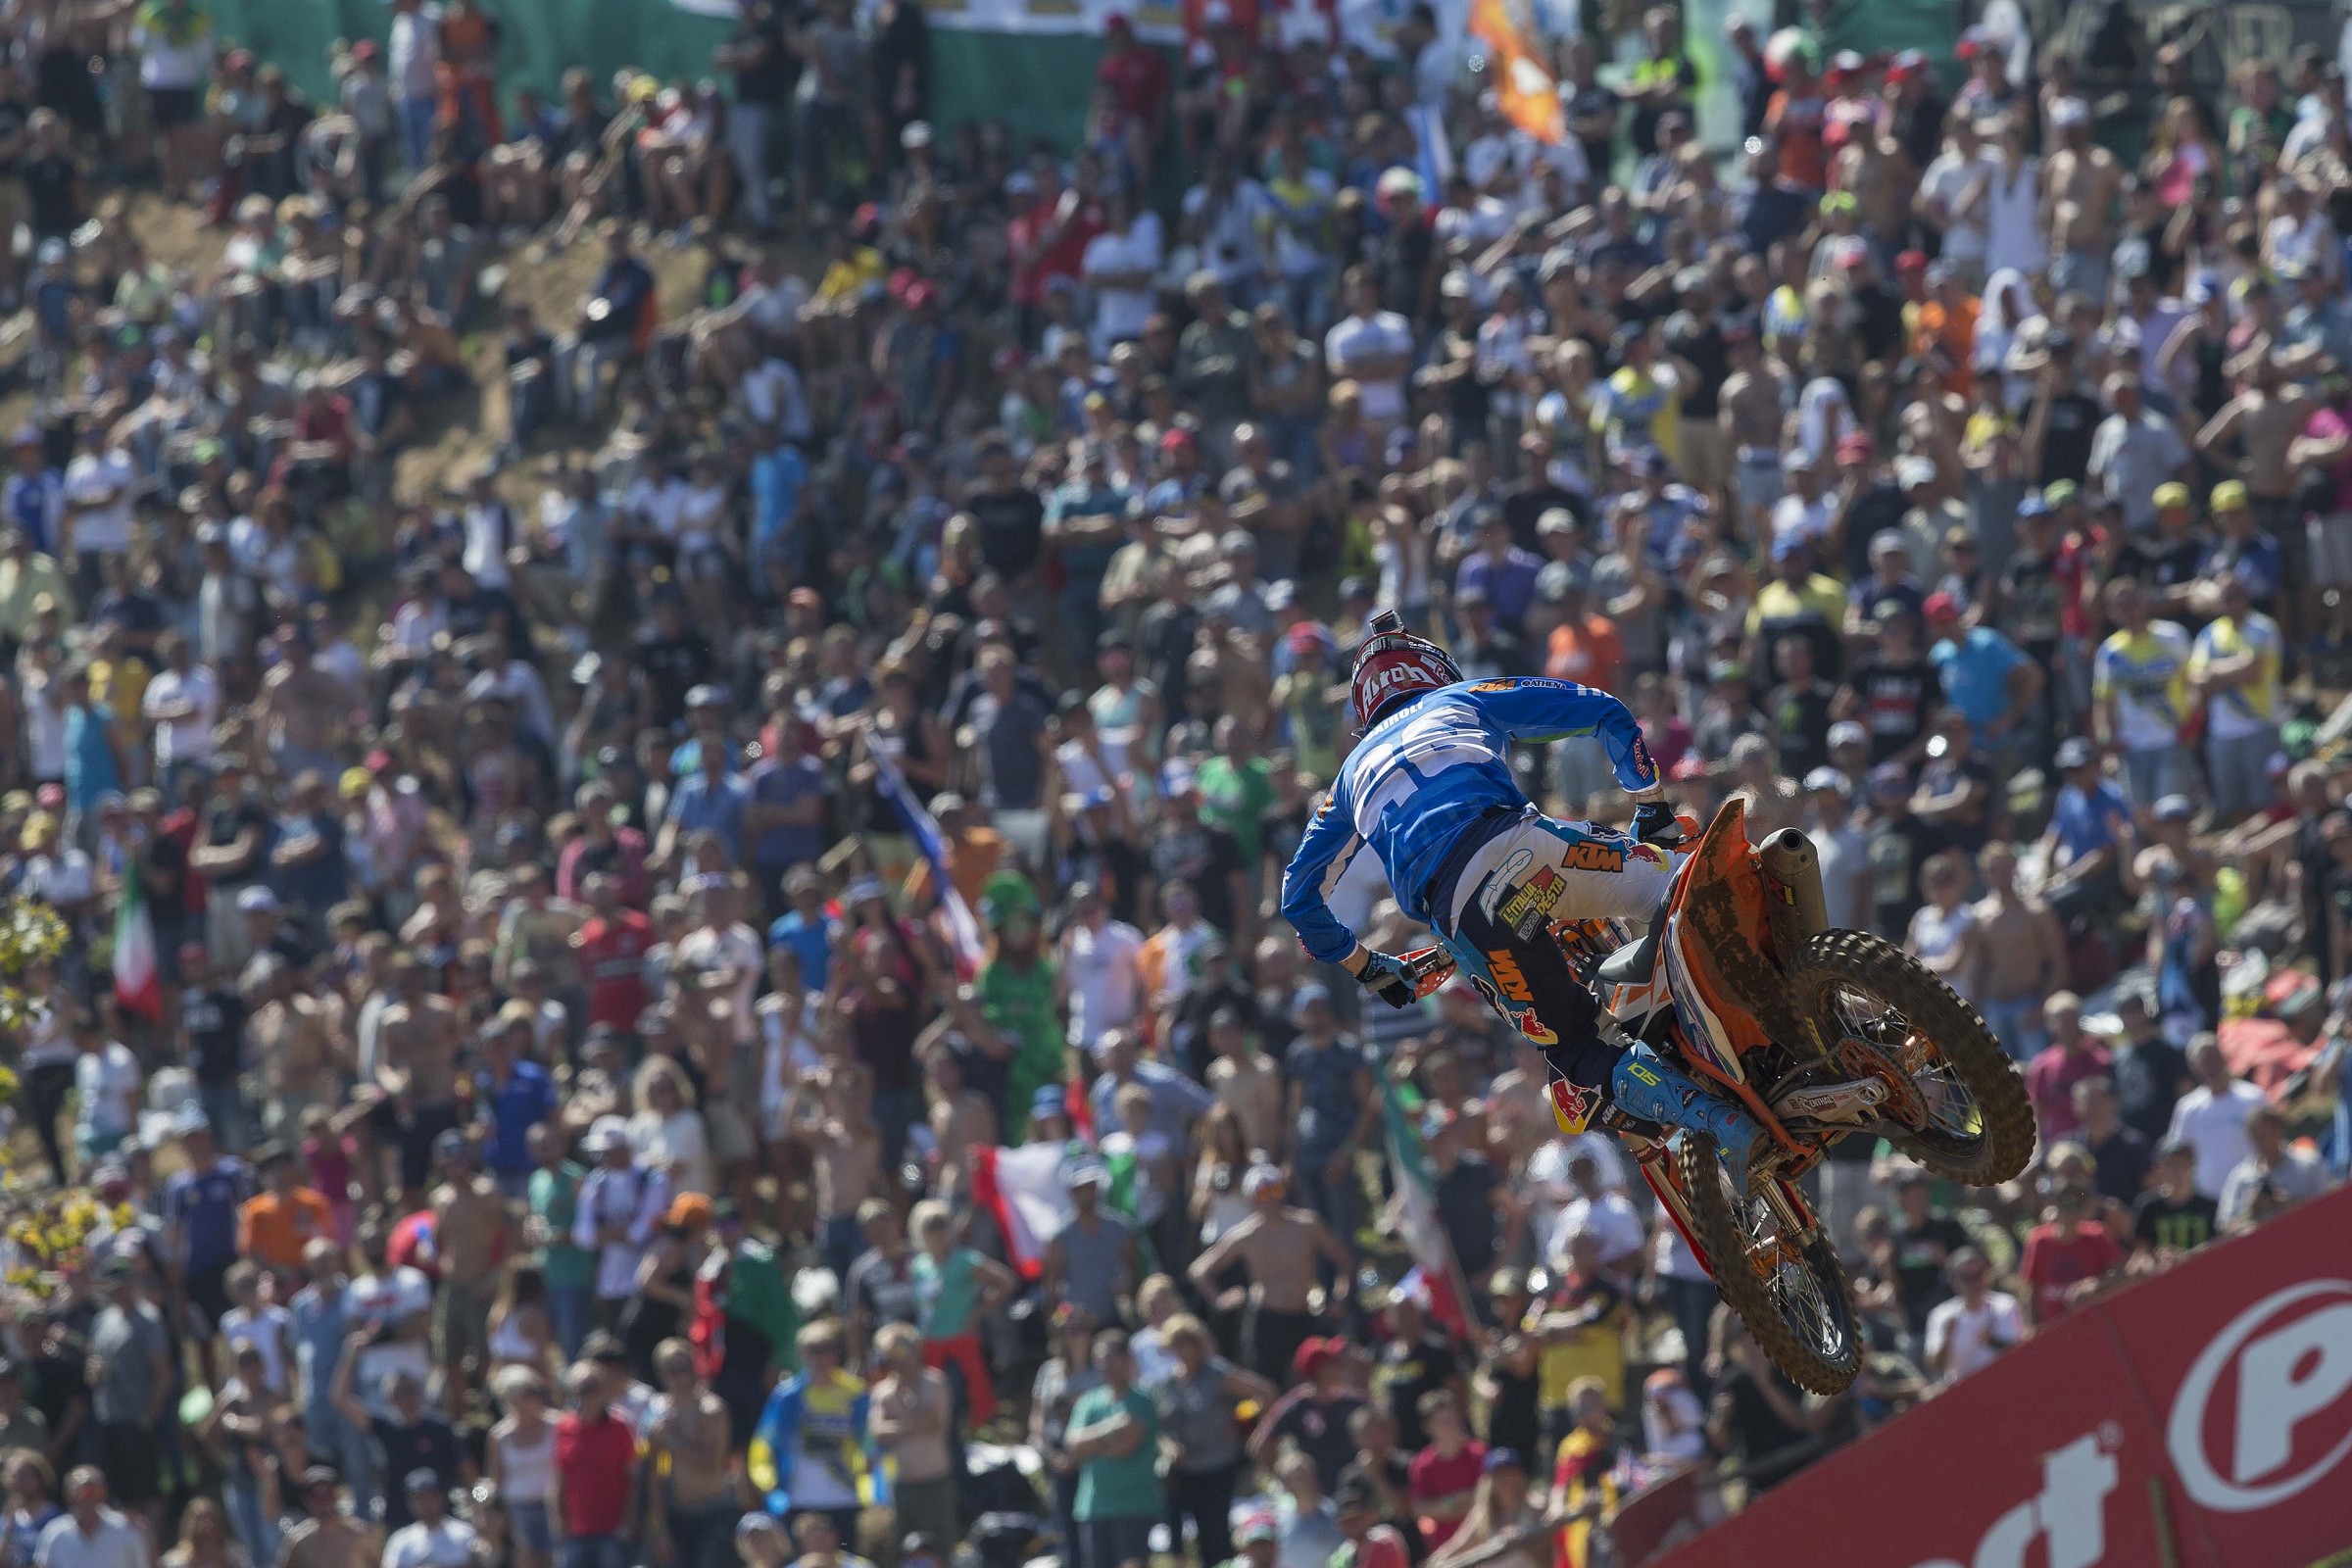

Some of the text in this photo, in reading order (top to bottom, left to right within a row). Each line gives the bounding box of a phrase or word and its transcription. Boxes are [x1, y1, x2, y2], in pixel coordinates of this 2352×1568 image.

[1530, 679, 1567, 690] ATHENA
[1561, 841, 1624, 873] KTM
[1501, 882, 1538, 924] L'ITALIA
[1536, 875, 1566, 916] DESTA
[1488, 949, 1535, 1002] KTM
[1601, 1103, 1618, 1125] KTM
